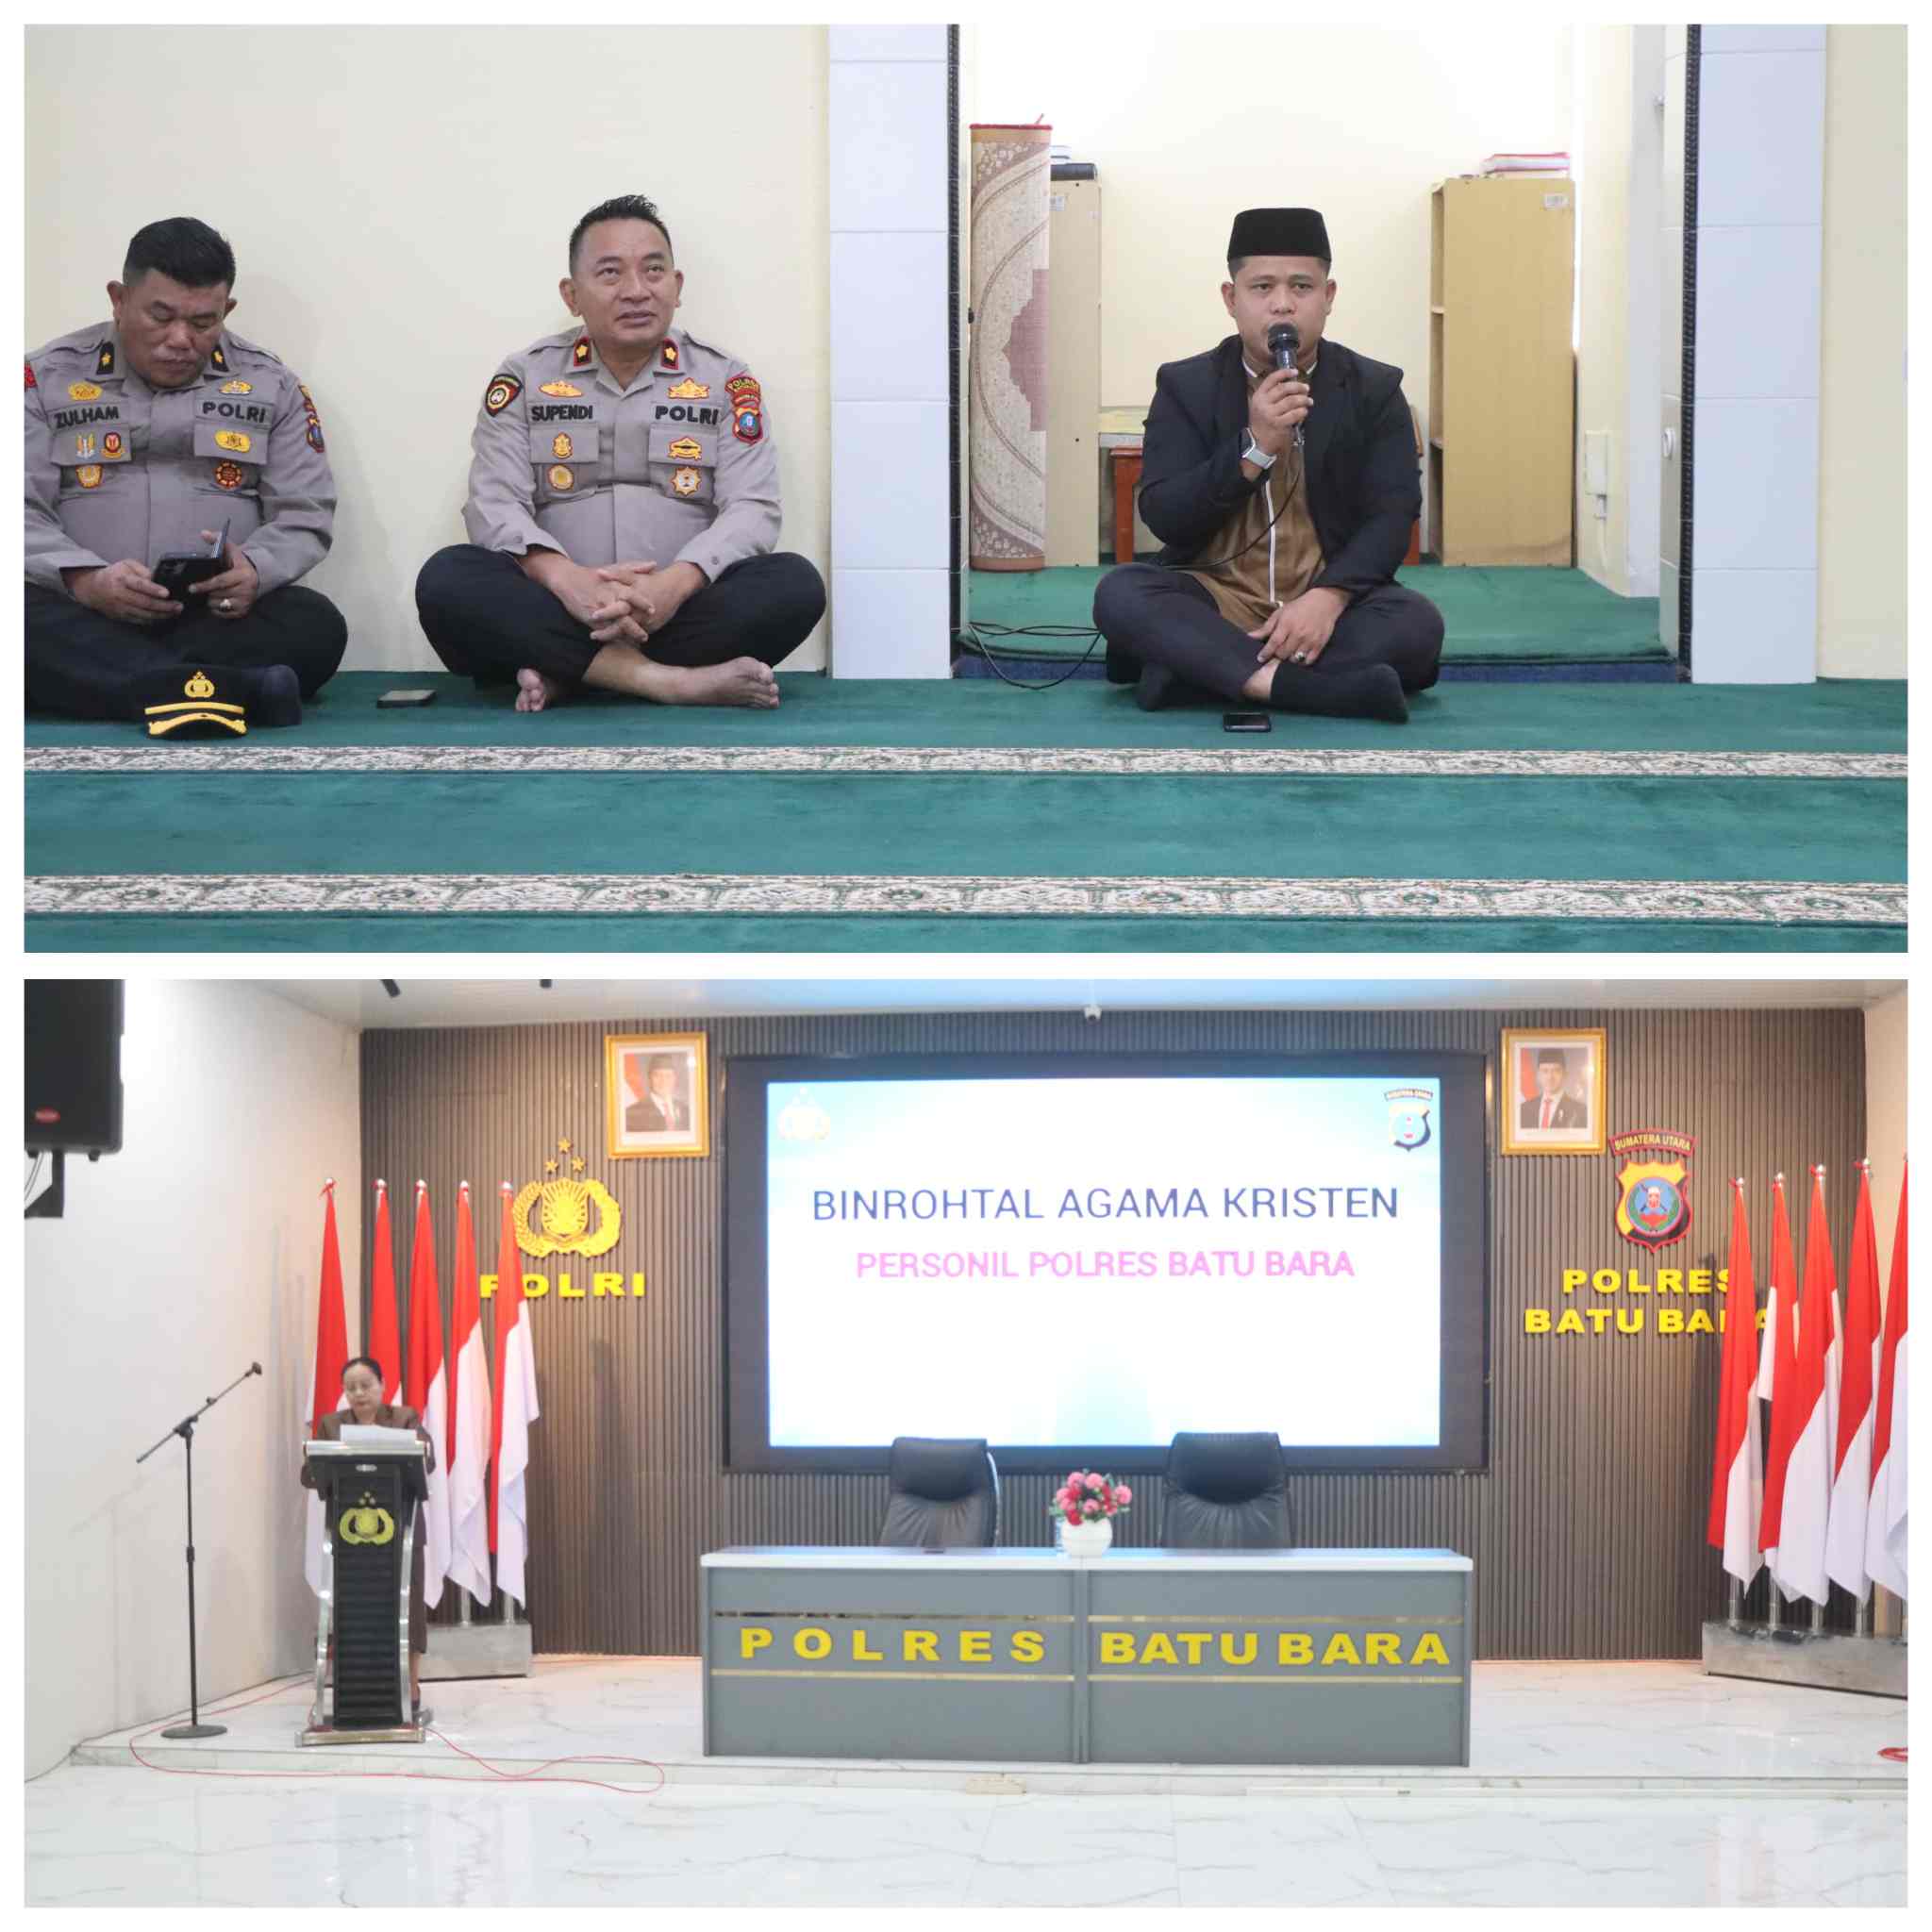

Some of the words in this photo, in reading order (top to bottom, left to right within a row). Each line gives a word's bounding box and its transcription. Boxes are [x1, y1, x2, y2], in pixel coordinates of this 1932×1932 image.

[54, 406, 120, 429] ZULHAM
[201, 401, 267, 424] POLRI
[531, 406, 593, 422] SUPENDI
[655, 406, 719, 425] POLRI
[1614, 1133, 1660, 1152] SUMATERA
[1662, 1135, 1690, 1152] UTARA
[812, 1190, 1044, 1221] BINROHTAL
[1057, 1188, 1209, 1219] AGAMA
[1224, 1187, 1399, 1218] KRISTEN
[856, 1252, 1019, 1279] PERSONIL
[1028, 1252, 1158, 1277] POLRES
[1168, 1251, 1255, 1277] BATU
[1264, 1250, 1356, 1276] BARA
[1524, 1308, 1644, 1334] BATU
[740, 1627, 1045, 1662] POLRES
[1100, 1632, 1258, 1665] BATU
[1278, 1633, 1450, 1665] BARA
